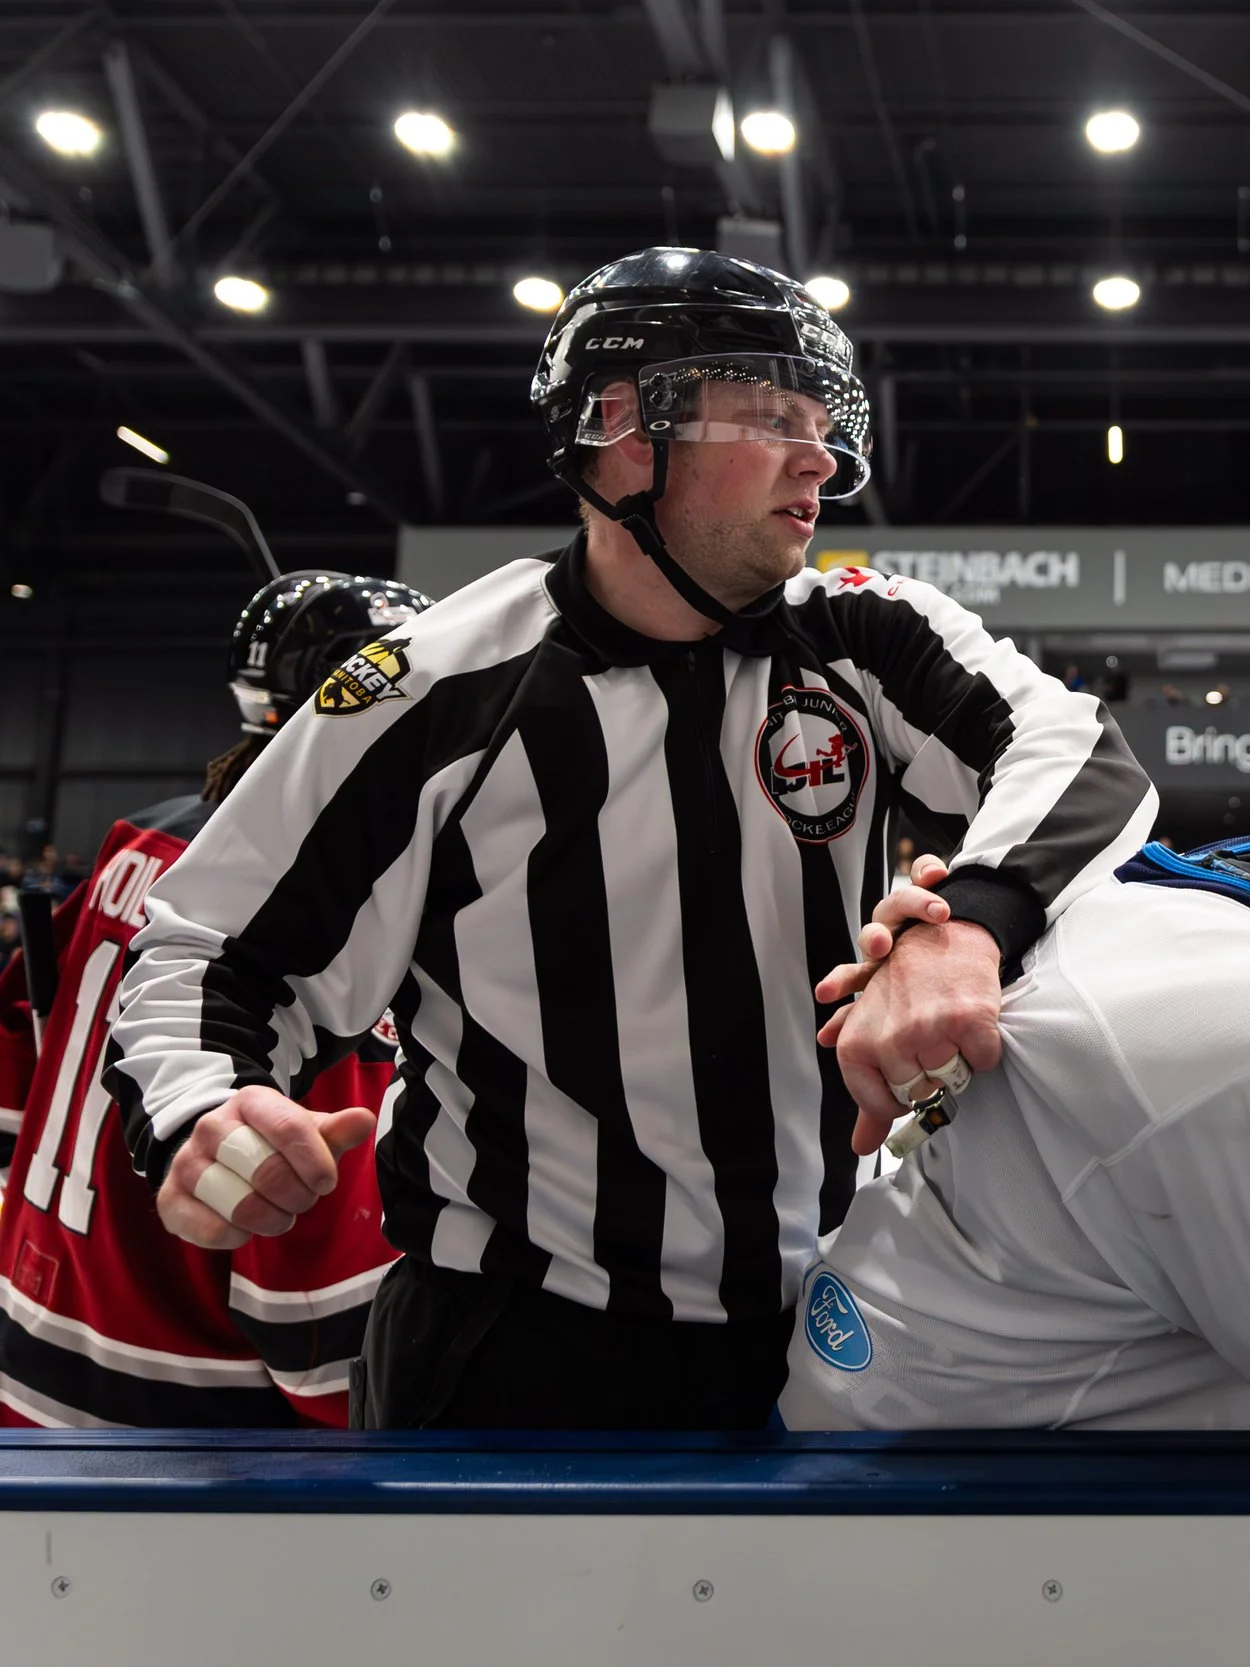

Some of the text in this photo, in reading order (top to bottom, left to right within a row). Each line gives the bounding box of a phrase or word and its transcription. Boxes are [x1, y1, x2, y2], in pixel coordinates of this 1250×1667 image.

[585, 337, 644, 350] CCM
[872, 551, 1079, 588] STEINBACH
[247, 641, 269, 667] 11
[340, 654, 401, 702] OCKEY
[23, 938, 123, 1236] 11
[811, 1285, 854, 1351] Ford
